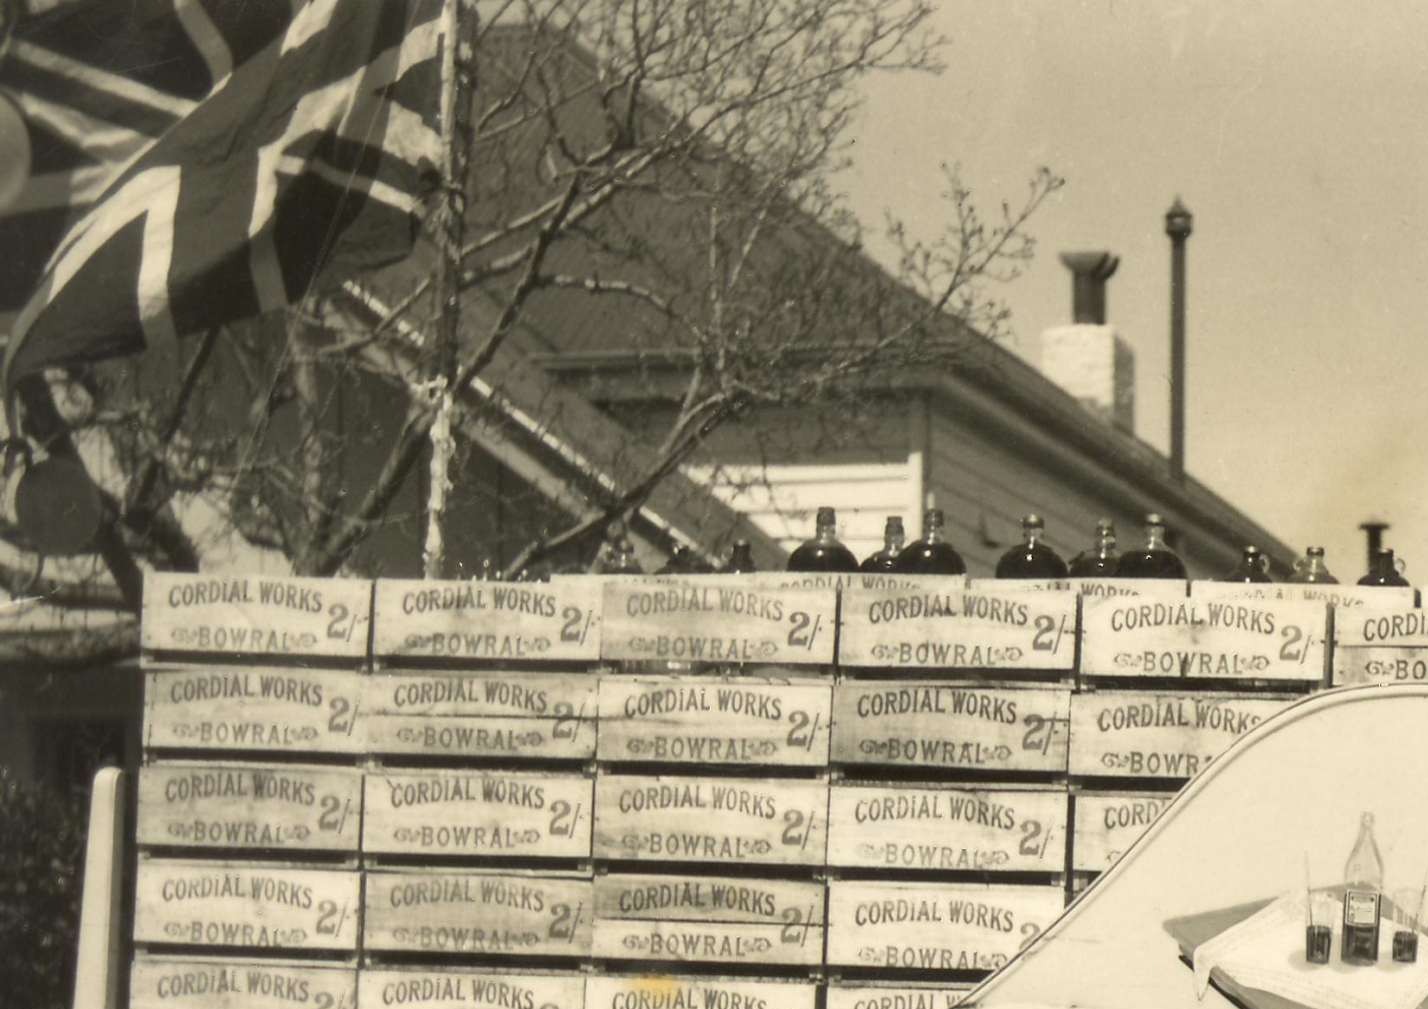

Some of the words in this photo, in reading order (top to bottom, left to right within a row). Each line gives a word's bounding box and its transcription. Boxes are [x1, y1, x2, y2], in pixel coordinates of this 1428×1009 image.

[169, 581, 253, 607] CORDIAL
[260, 583, 323, 613] WORKS
[403, 588, 486, 615] CORDIAL
[494, 589, 556, 617] WORKS
[626, 591, 713, 617] CORDIAL
[719, 593, 783, 622] WORKS
[868, 595, 957, 625] CORDIAL
[962, 597, 1028, 626] WORKS
[1111, 604, 1202, 633] CORDIAL
[1208, 604, 1275, 635] WORKS
[198, 627, 292, 650] BOWRAL
[431, 633, 525, 657] BOWRAL
[657, 637, 751, 660] BOWRAL
[901, 643, 996, 665] BOWRAL
[1143, 652, 1241, 676] BOWRAL
[171, 675, 254, 704] CORDIAL
[260, 677, 323, 706] WORKS
[394, 680, 478, 708] CORDIAL
[485, 684, 547, 714] WORKS
[624, 688, 710, 718] CORDIAL
[717, 690, 782, 721] WORKS
[857, 689, 945, 718] CORDIAL
[952, 692, 1017, 725] WORKS
[1097, 703, 1189, 732] CORDIAL
[200, 722, 293, 745] BOWRAL
[424, 727, 517, 750] BOWRAL
[656, 737, 751, 760] BOWRAL
[888, 740, 984, 763] BOWRAL
[1130, 751, 1213, 774] BOWR
[166, 774, 249, 803] CORDIAL
[254, 776, 316, 806] WORKS
[391, 780, 476, 808] CORDIAL
[483, 782, 545, 811] WORKS
[619, 785, 705, 813] CORDIAL
[712, 789, 776, 819] WORKS
[855, 798, 943, 821] CORDIAL
[951, 798, 1015, 830] WORKS
[194, 821, 284, 845] BOWRAL
[420, 824, 515, 847] BOWRAL
[650, 833, 744, 856] BOWRAL
[885, 844, 984, 866] BOWRAL
[162, 873, 245, 901] CORDIAL
[250, 876, 313, 909] WORKS
[390, 880, 474, 908] CORDIAL
[481, 881, 545, 911] WORKS
[619, 883, 705, 913] CORDIAL
[711, 887, 776, 916] WORKS
[855, 899, 942, 926] CORDIAL
[950, 899, 1014, 932] WORKS
[191, 922, 281, 946] BOWRAL
[420, 928, 514, 951] BOWRAL
[651, 934, 746, 956] BOWRAL
[157, 972, 241, 998] CORDIAL
[246, 973, 310, 1002] WORKS
[382, 978, 466, 1006] CORDIAL
